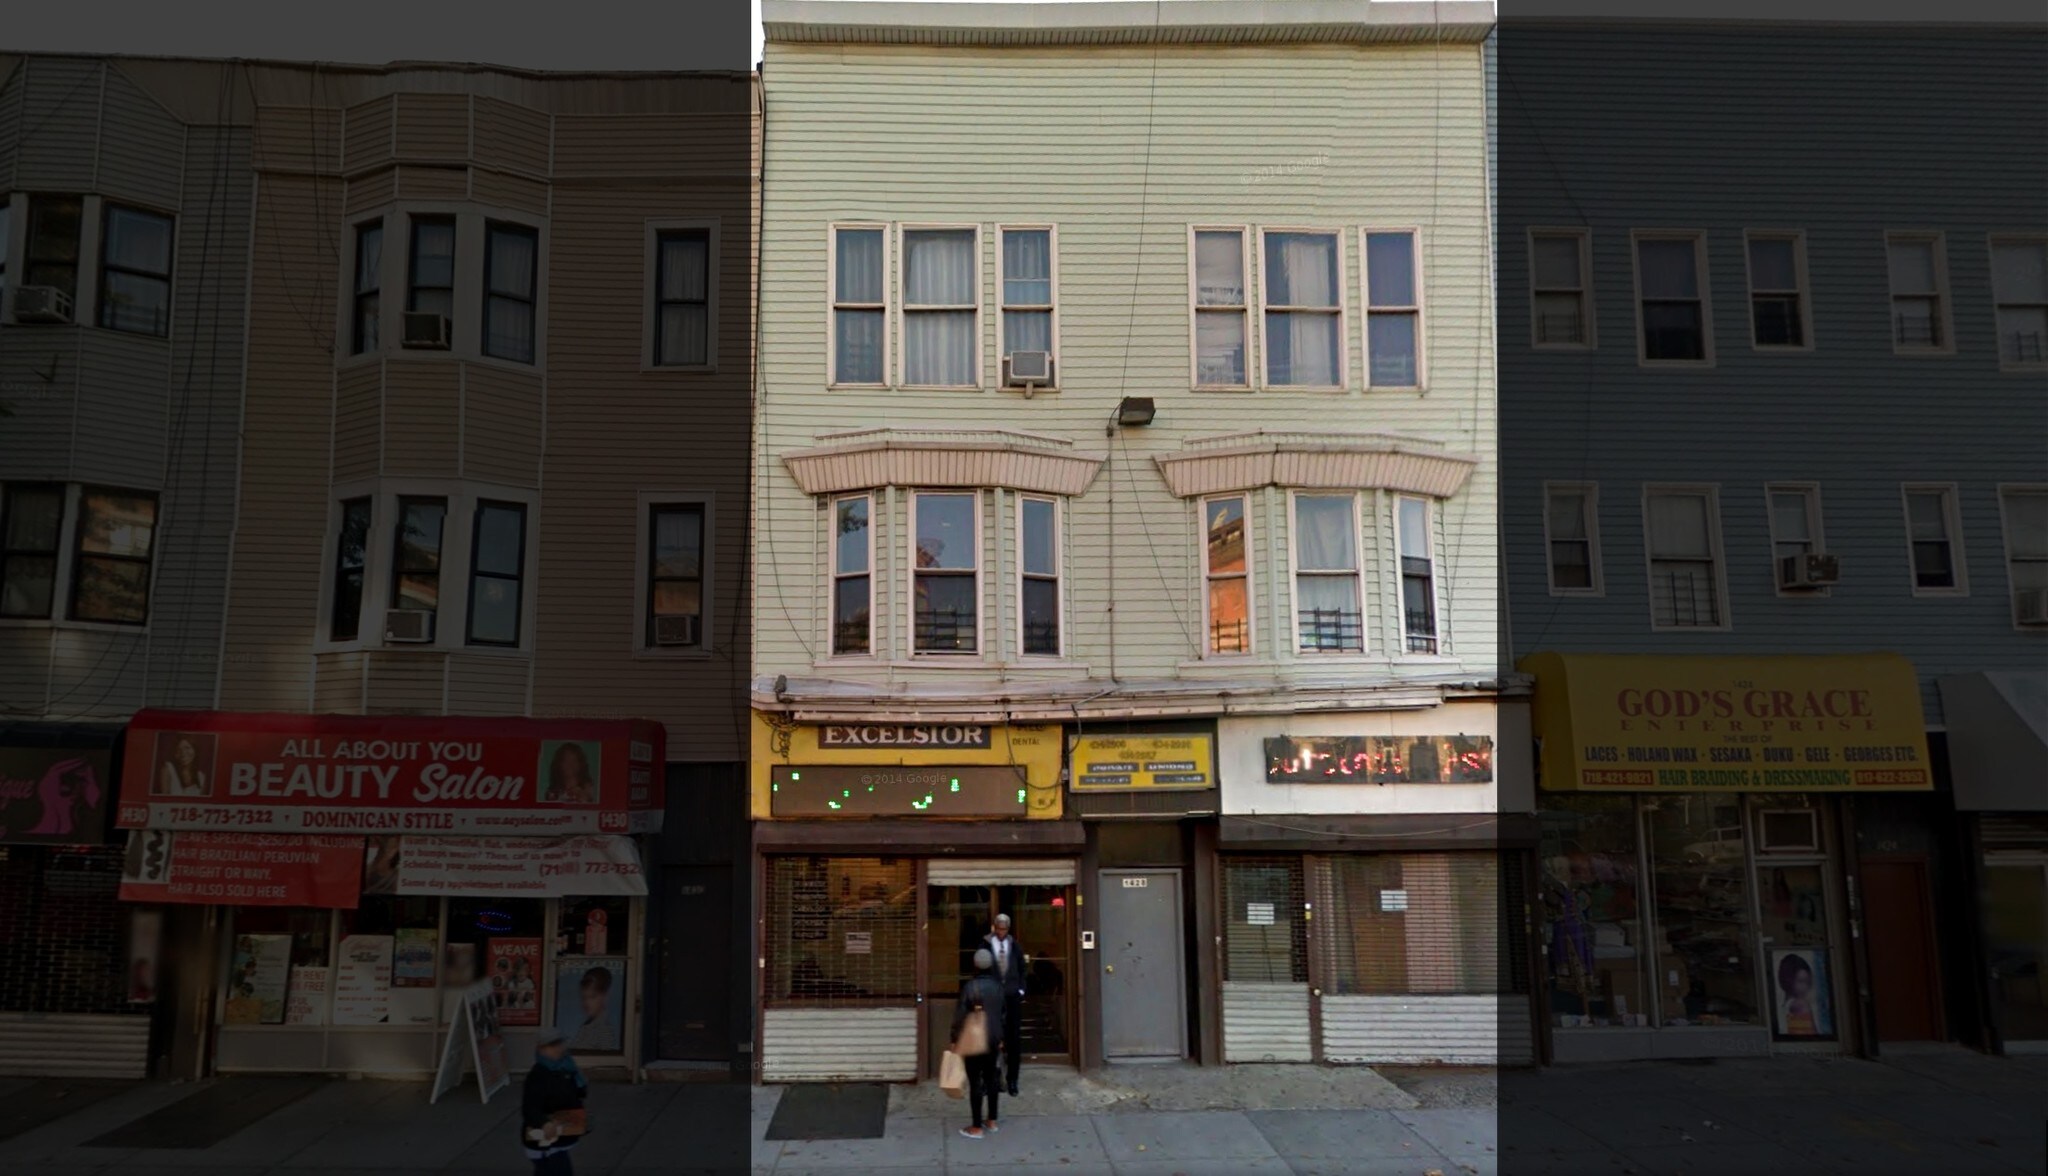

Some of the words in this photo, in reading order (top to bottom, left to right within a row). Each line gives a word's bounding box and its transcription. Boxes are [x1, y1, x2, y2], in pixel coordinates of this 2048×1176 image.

[1617, 688, 1734, 718] GOD'S
[1743, 688, 1873, 718] GRACE
[1620, 719, 1878, 732] ENTERPRISE
[824, 726, 983, 744] EXCELSIOR
[280, 739, 326, 758] ALL
[332, 740, 421, 761] ABOUT
[428, 741, 482, 761] YOU
[1584, 746, 1618, 762] LACES
[1671, 746, 1698, 762] WAX
[1709, 746, 1752, 762] SESAKA
[229, 762, 400, 799] BEAUTY
[412, 762, 525, 802] Salon
[1658, 769, 1688, 786] HAIR
[1691, 769, 1749, 786] BRAIDING
[1764, 769, 1850, 786] DRESSMAKING
[169, 807, 273, 825] 718-773-7322
[302, 811, 400, 828] DOMINICAN
[404, 812, 454, 829] STYLE
[600, 812, 627, 828] 1430
[170, 864, 221, 878] STRAIGHT
[224, 866, 241, 879] OR
[168, 882, 194, 894] HAIR
[195, 883, 224, 896] ALSO
[226, 884, 255, 897] SOLD
[256, 885, 288, 898] HERE
[492, 944, 540, 956] WEAVE
